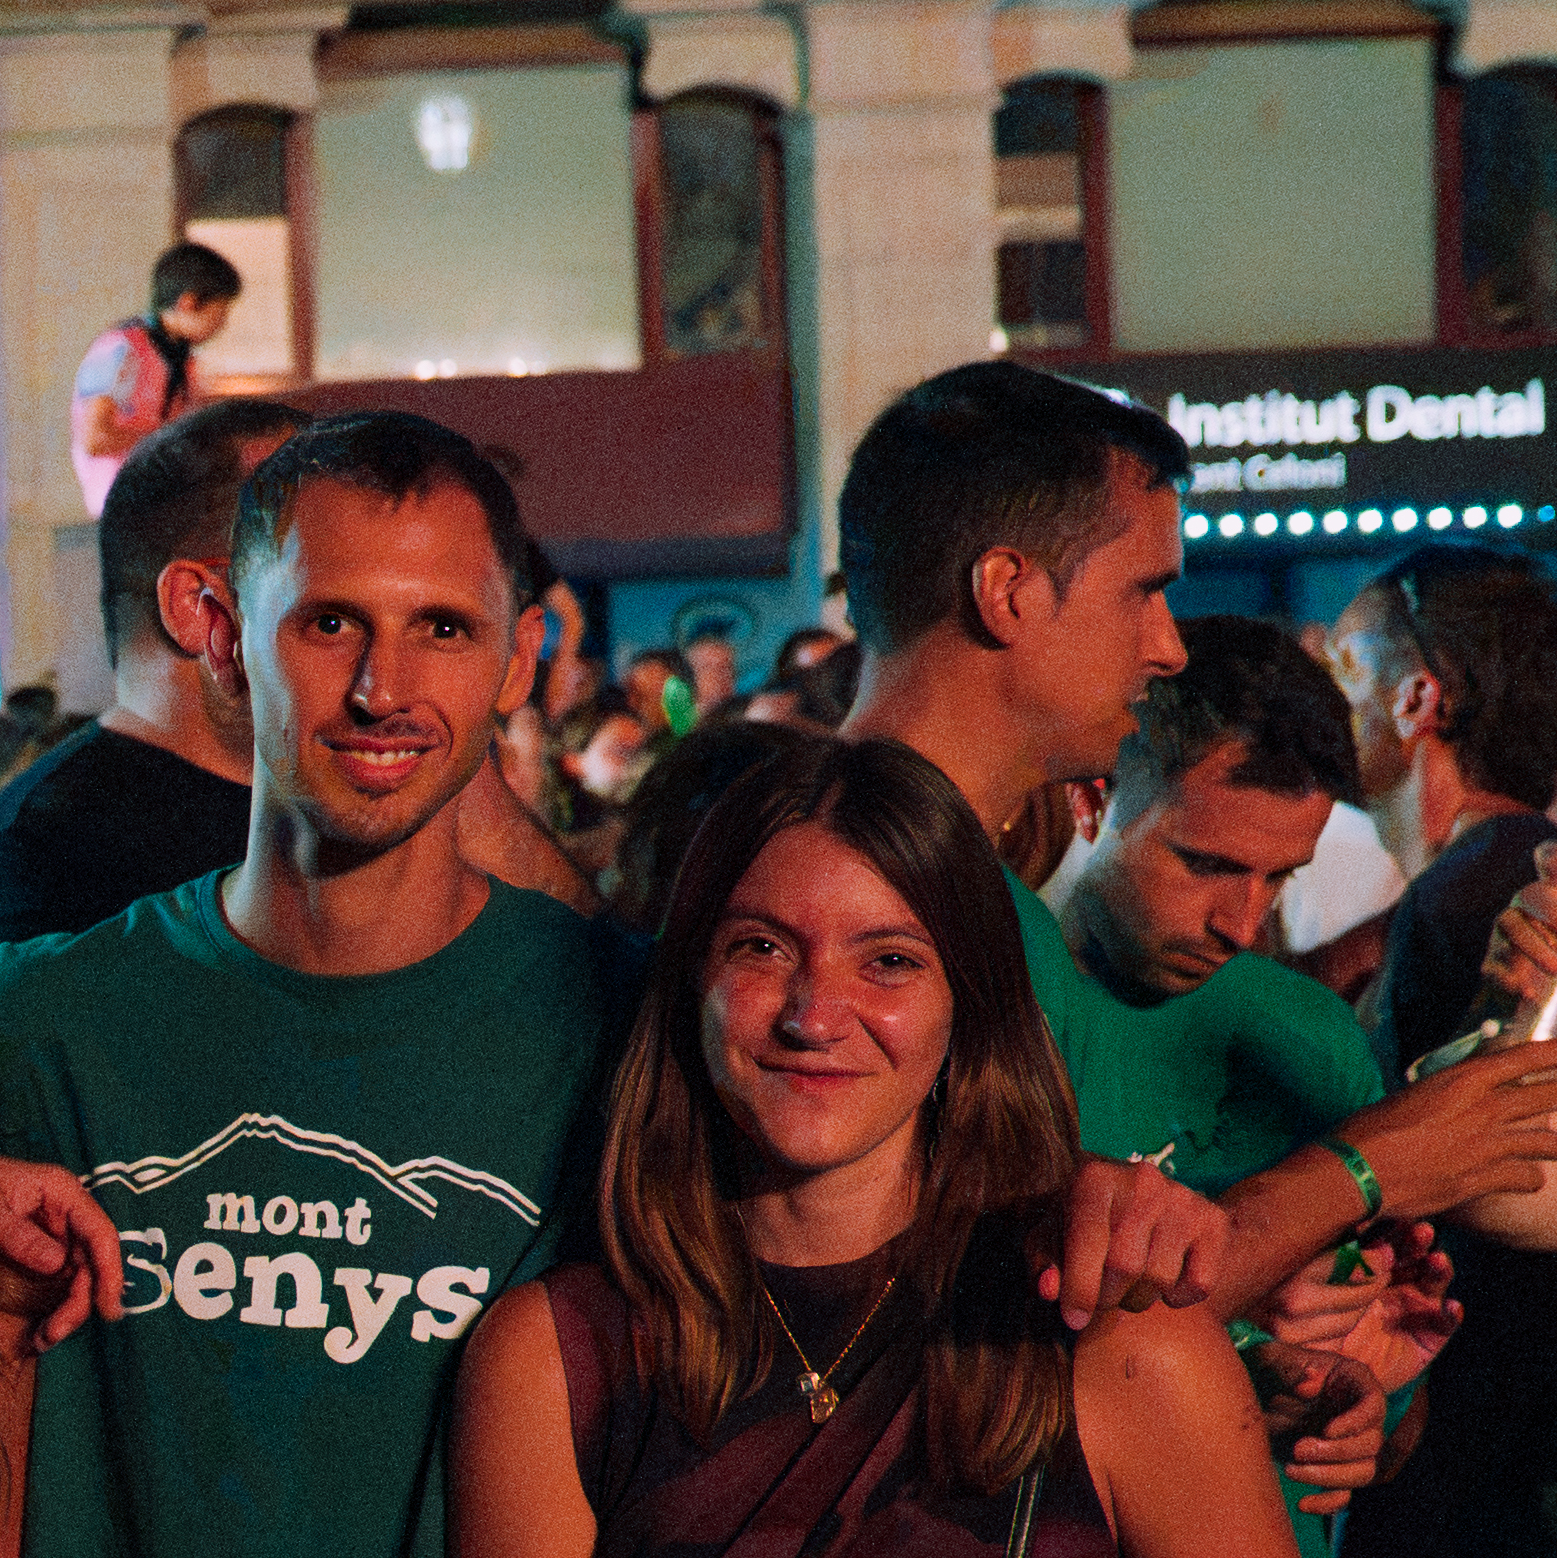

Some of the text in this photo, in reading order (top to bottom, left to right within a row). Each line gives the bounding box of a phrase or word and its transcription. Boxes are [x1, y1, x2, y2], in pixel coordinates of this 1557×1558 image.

[1169, 377, 1546, 448] Institut Dental
[203, 1192, 372, 1245] mont
